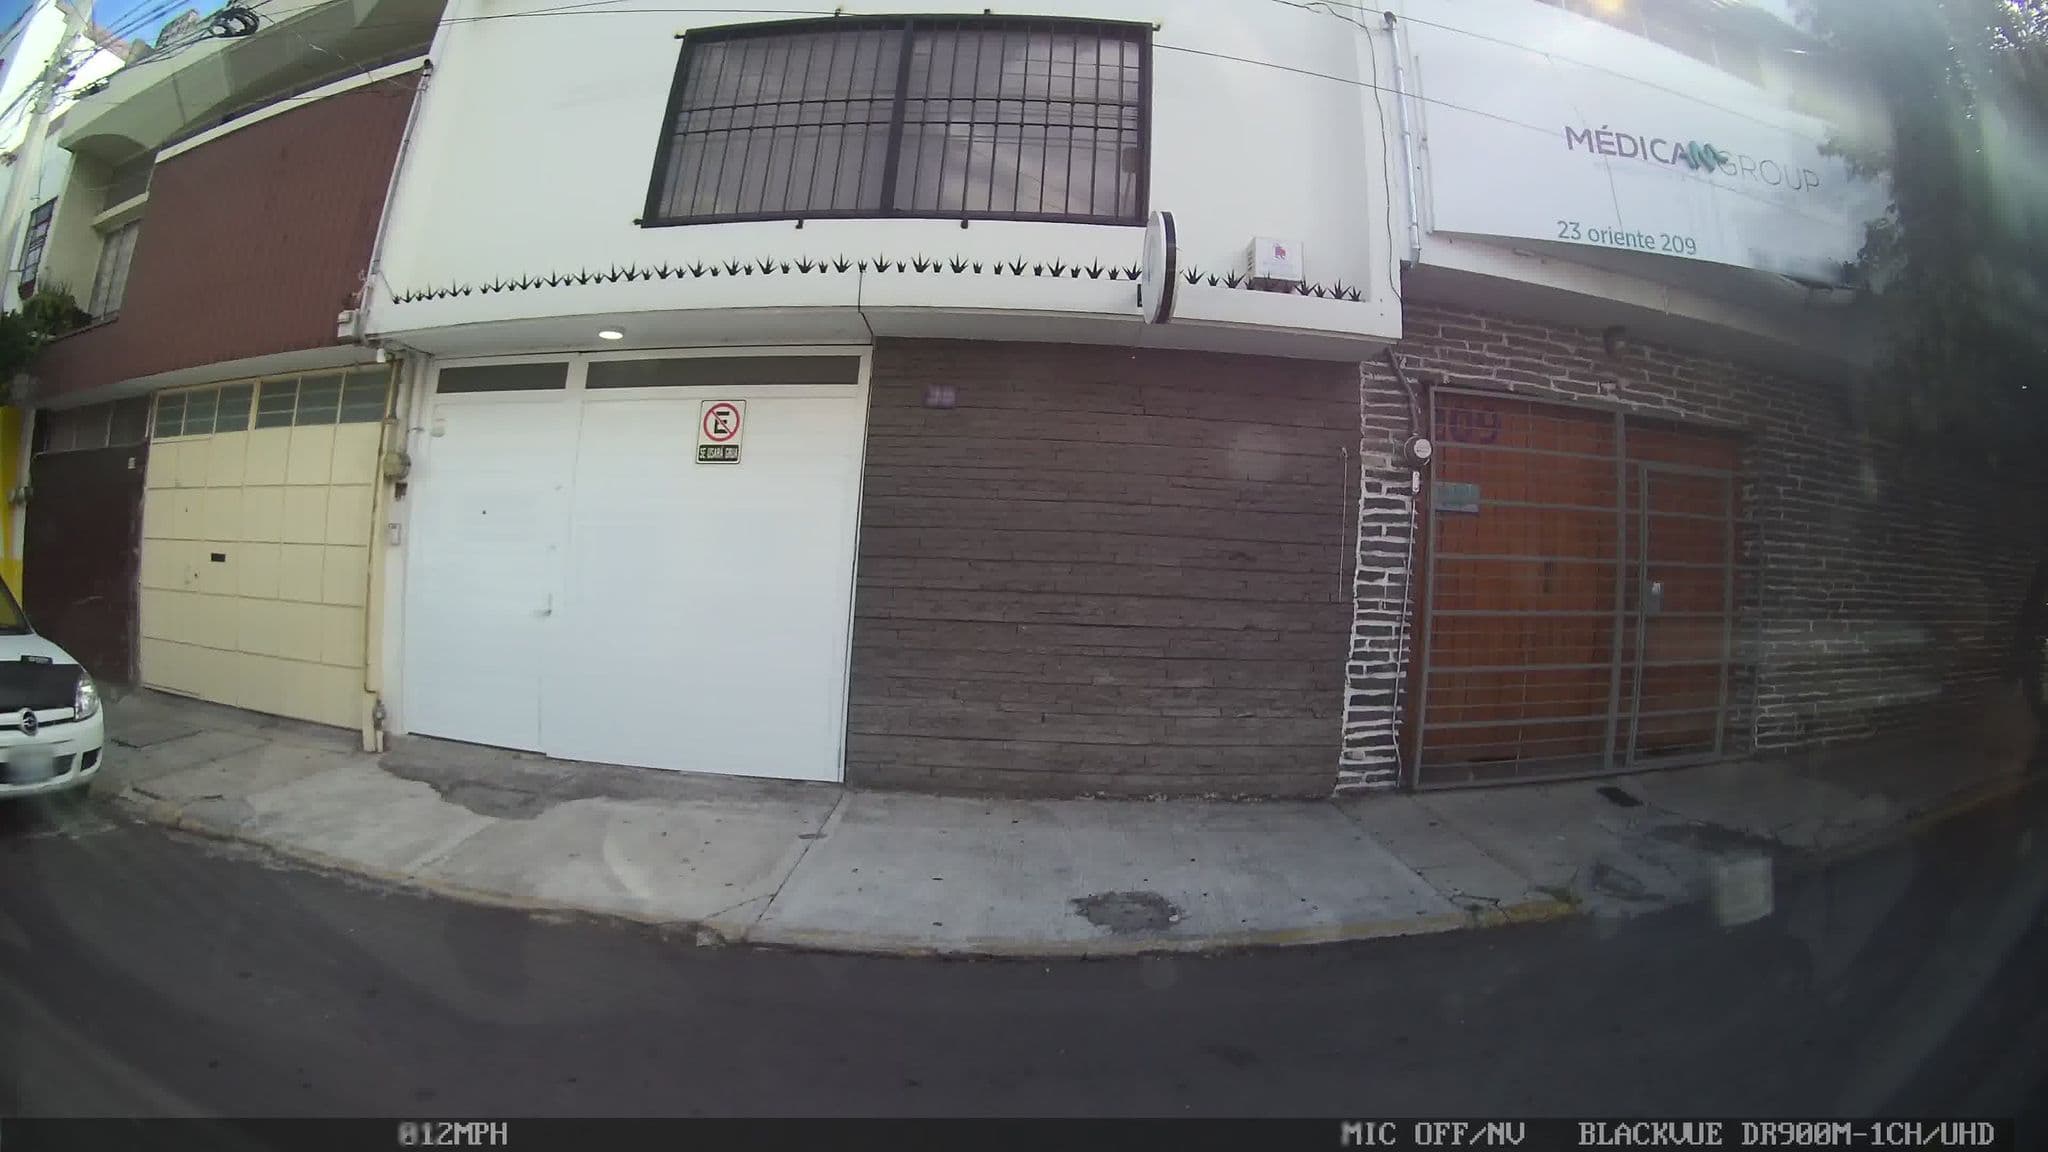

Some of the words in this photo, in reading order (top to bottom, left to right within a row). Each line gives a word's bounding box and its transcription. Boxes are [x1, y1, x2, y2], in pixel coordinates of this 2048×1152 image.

[1716, 149, 1821, 193] GROUP
[1557, 220, 1581, 240] 23
[1587, 226, 1655, 249] oriente
[1660, 233, 1697, 255] 209
